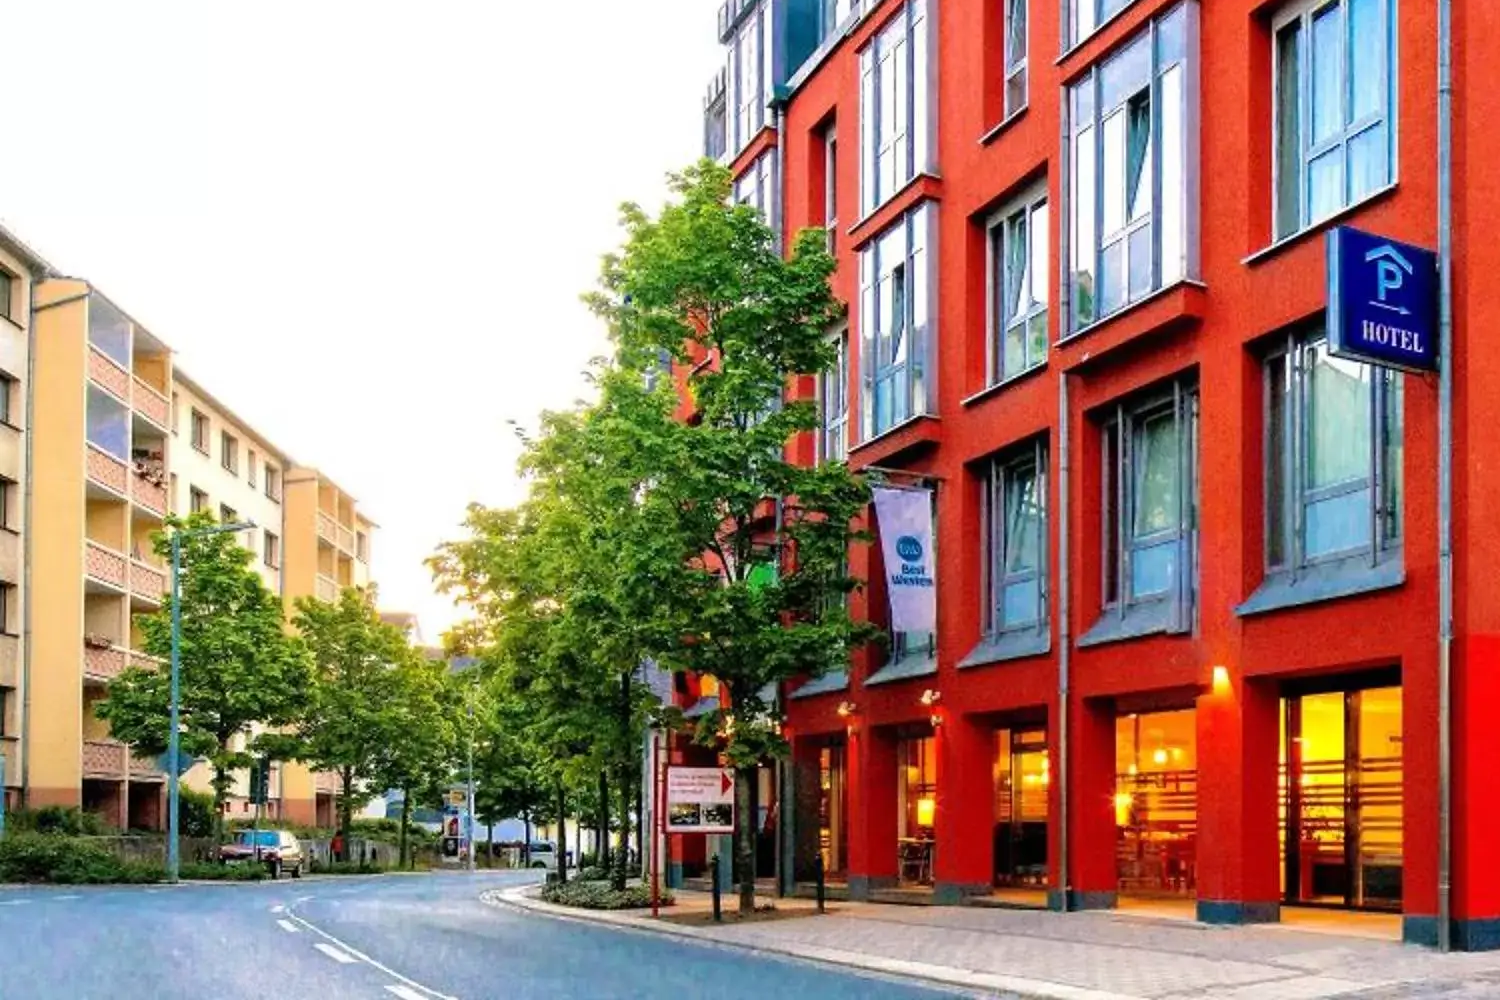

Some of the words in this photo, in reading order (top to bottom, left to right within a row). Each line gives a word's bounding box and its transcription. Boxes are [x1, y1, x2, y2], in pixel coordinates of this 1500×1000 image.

[1377, 260, 1402, 300] P
[1362, 320, 1424, 353] HOTEL
[901, 564, 925, 575] Best
